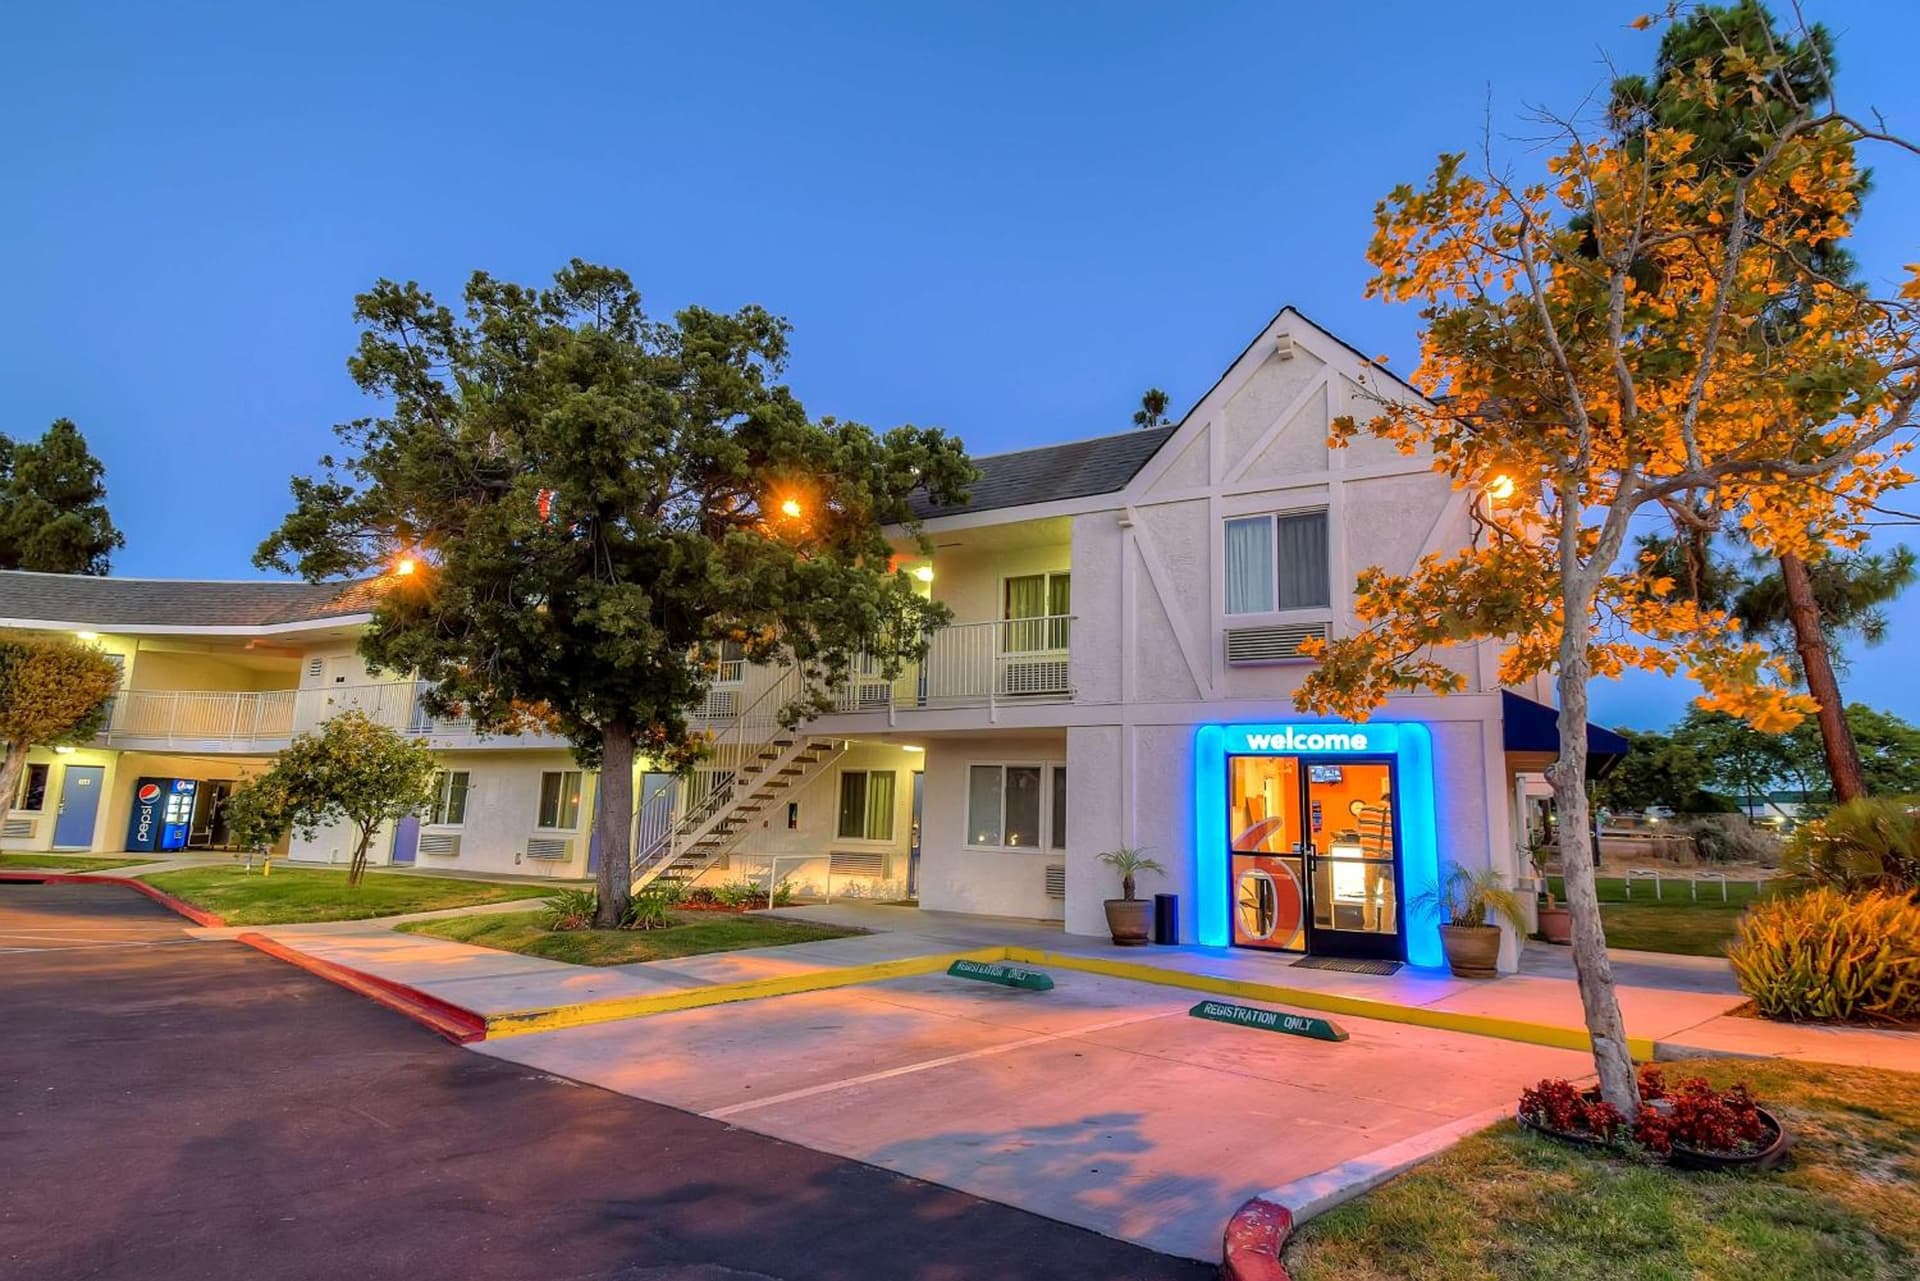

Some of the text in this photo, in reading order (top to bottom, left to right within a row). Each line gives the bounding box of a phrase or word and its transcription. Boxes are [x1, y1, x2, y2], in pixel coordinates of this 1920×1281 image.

[1246, 726, 1368, 750] welcome
[137, 805, 153, 842] pepsi
[1203, 1003, 1314, 1032] REGISTRATION ONLY
